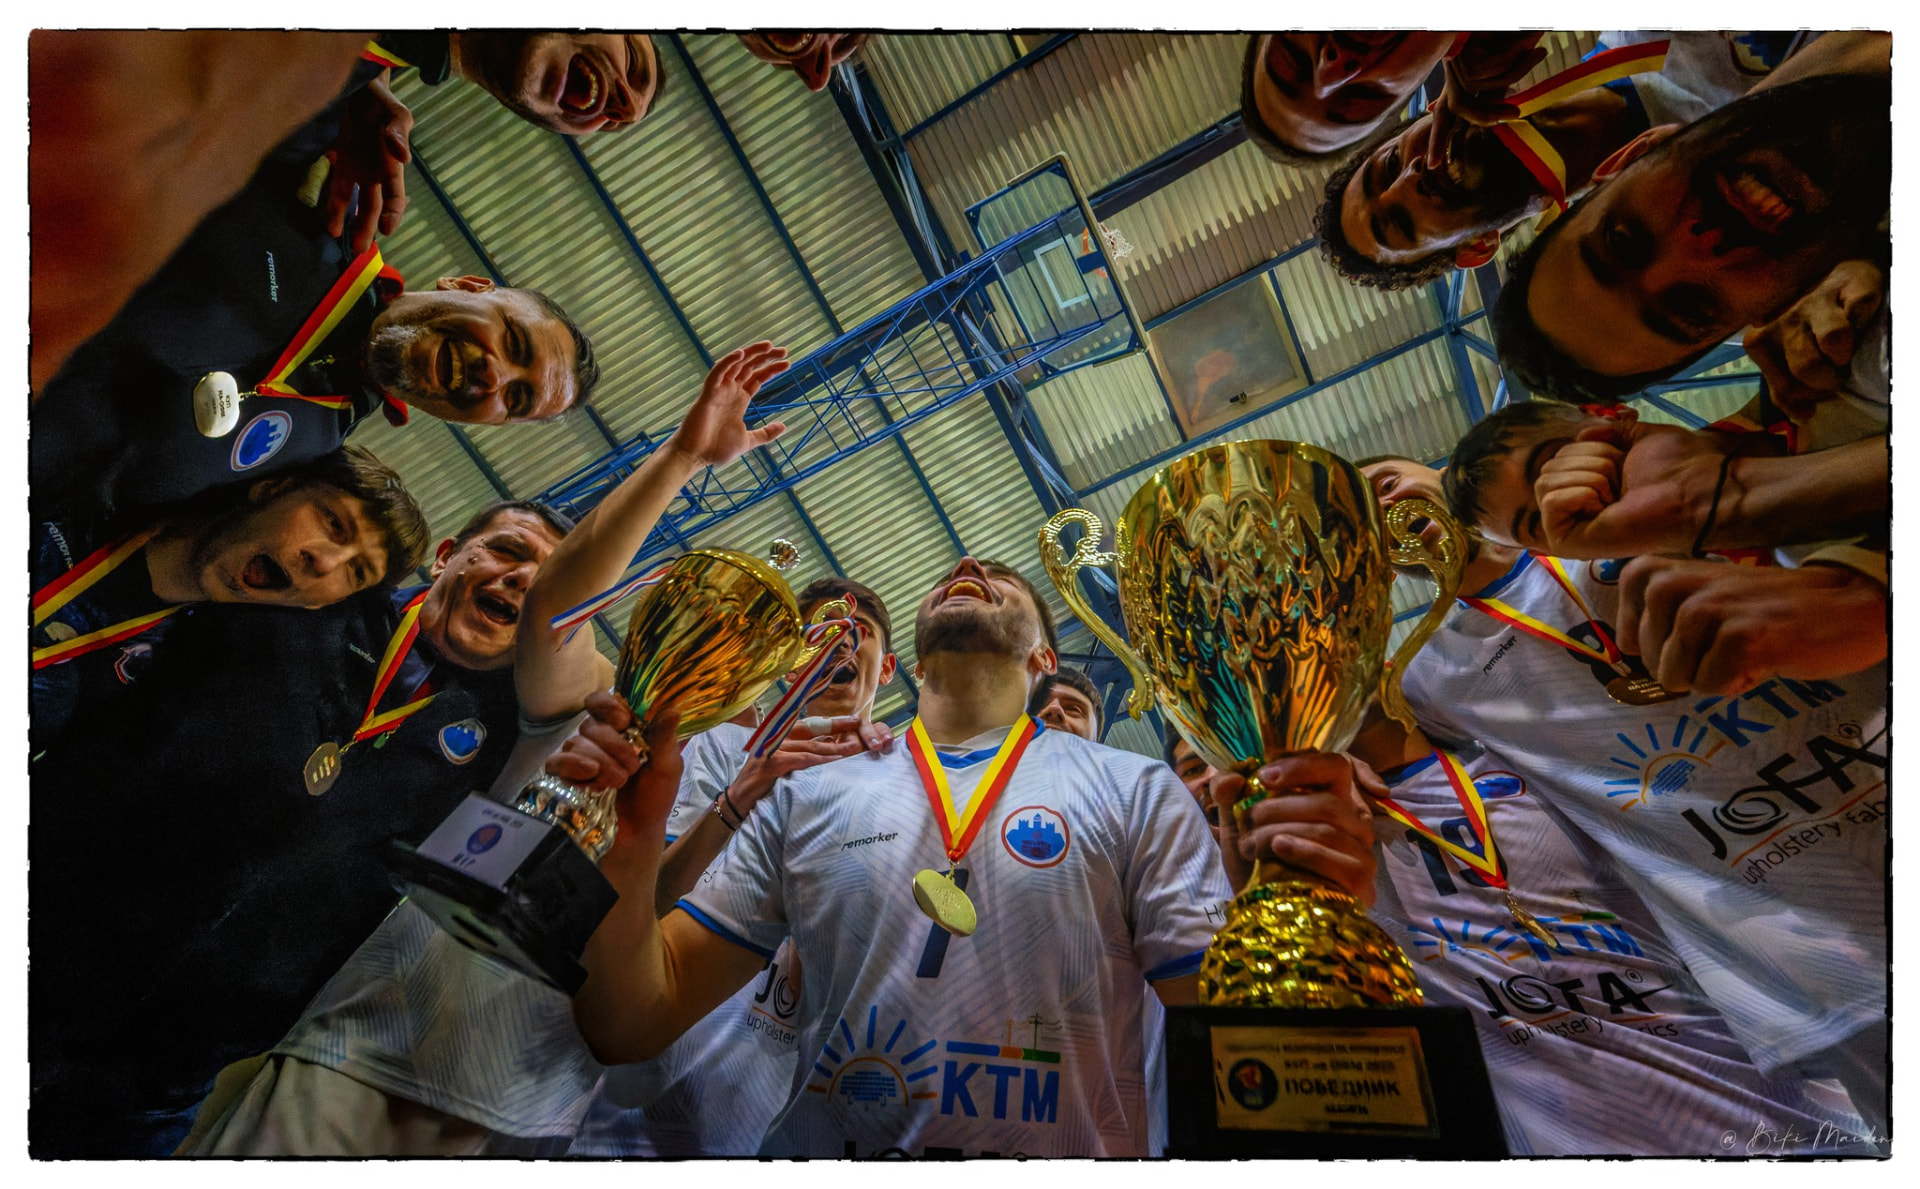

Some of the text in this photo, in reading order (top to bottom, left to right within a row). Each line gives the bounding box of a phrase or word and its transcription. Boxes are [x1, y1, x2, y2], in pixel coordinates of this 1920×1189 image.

[266, 250, 278, 302] remorker
[1483, 635, 1517, 675] remorker
[1680, 734, 1887, 861] JOFA
[841, 832, 898, 851] remorker
[1742, 820, 1841, 884] upholstery
[940, 1060, 1060, 1124] KTM
[1284, 1077, 1400, 1098] ПОБЕДНИК
